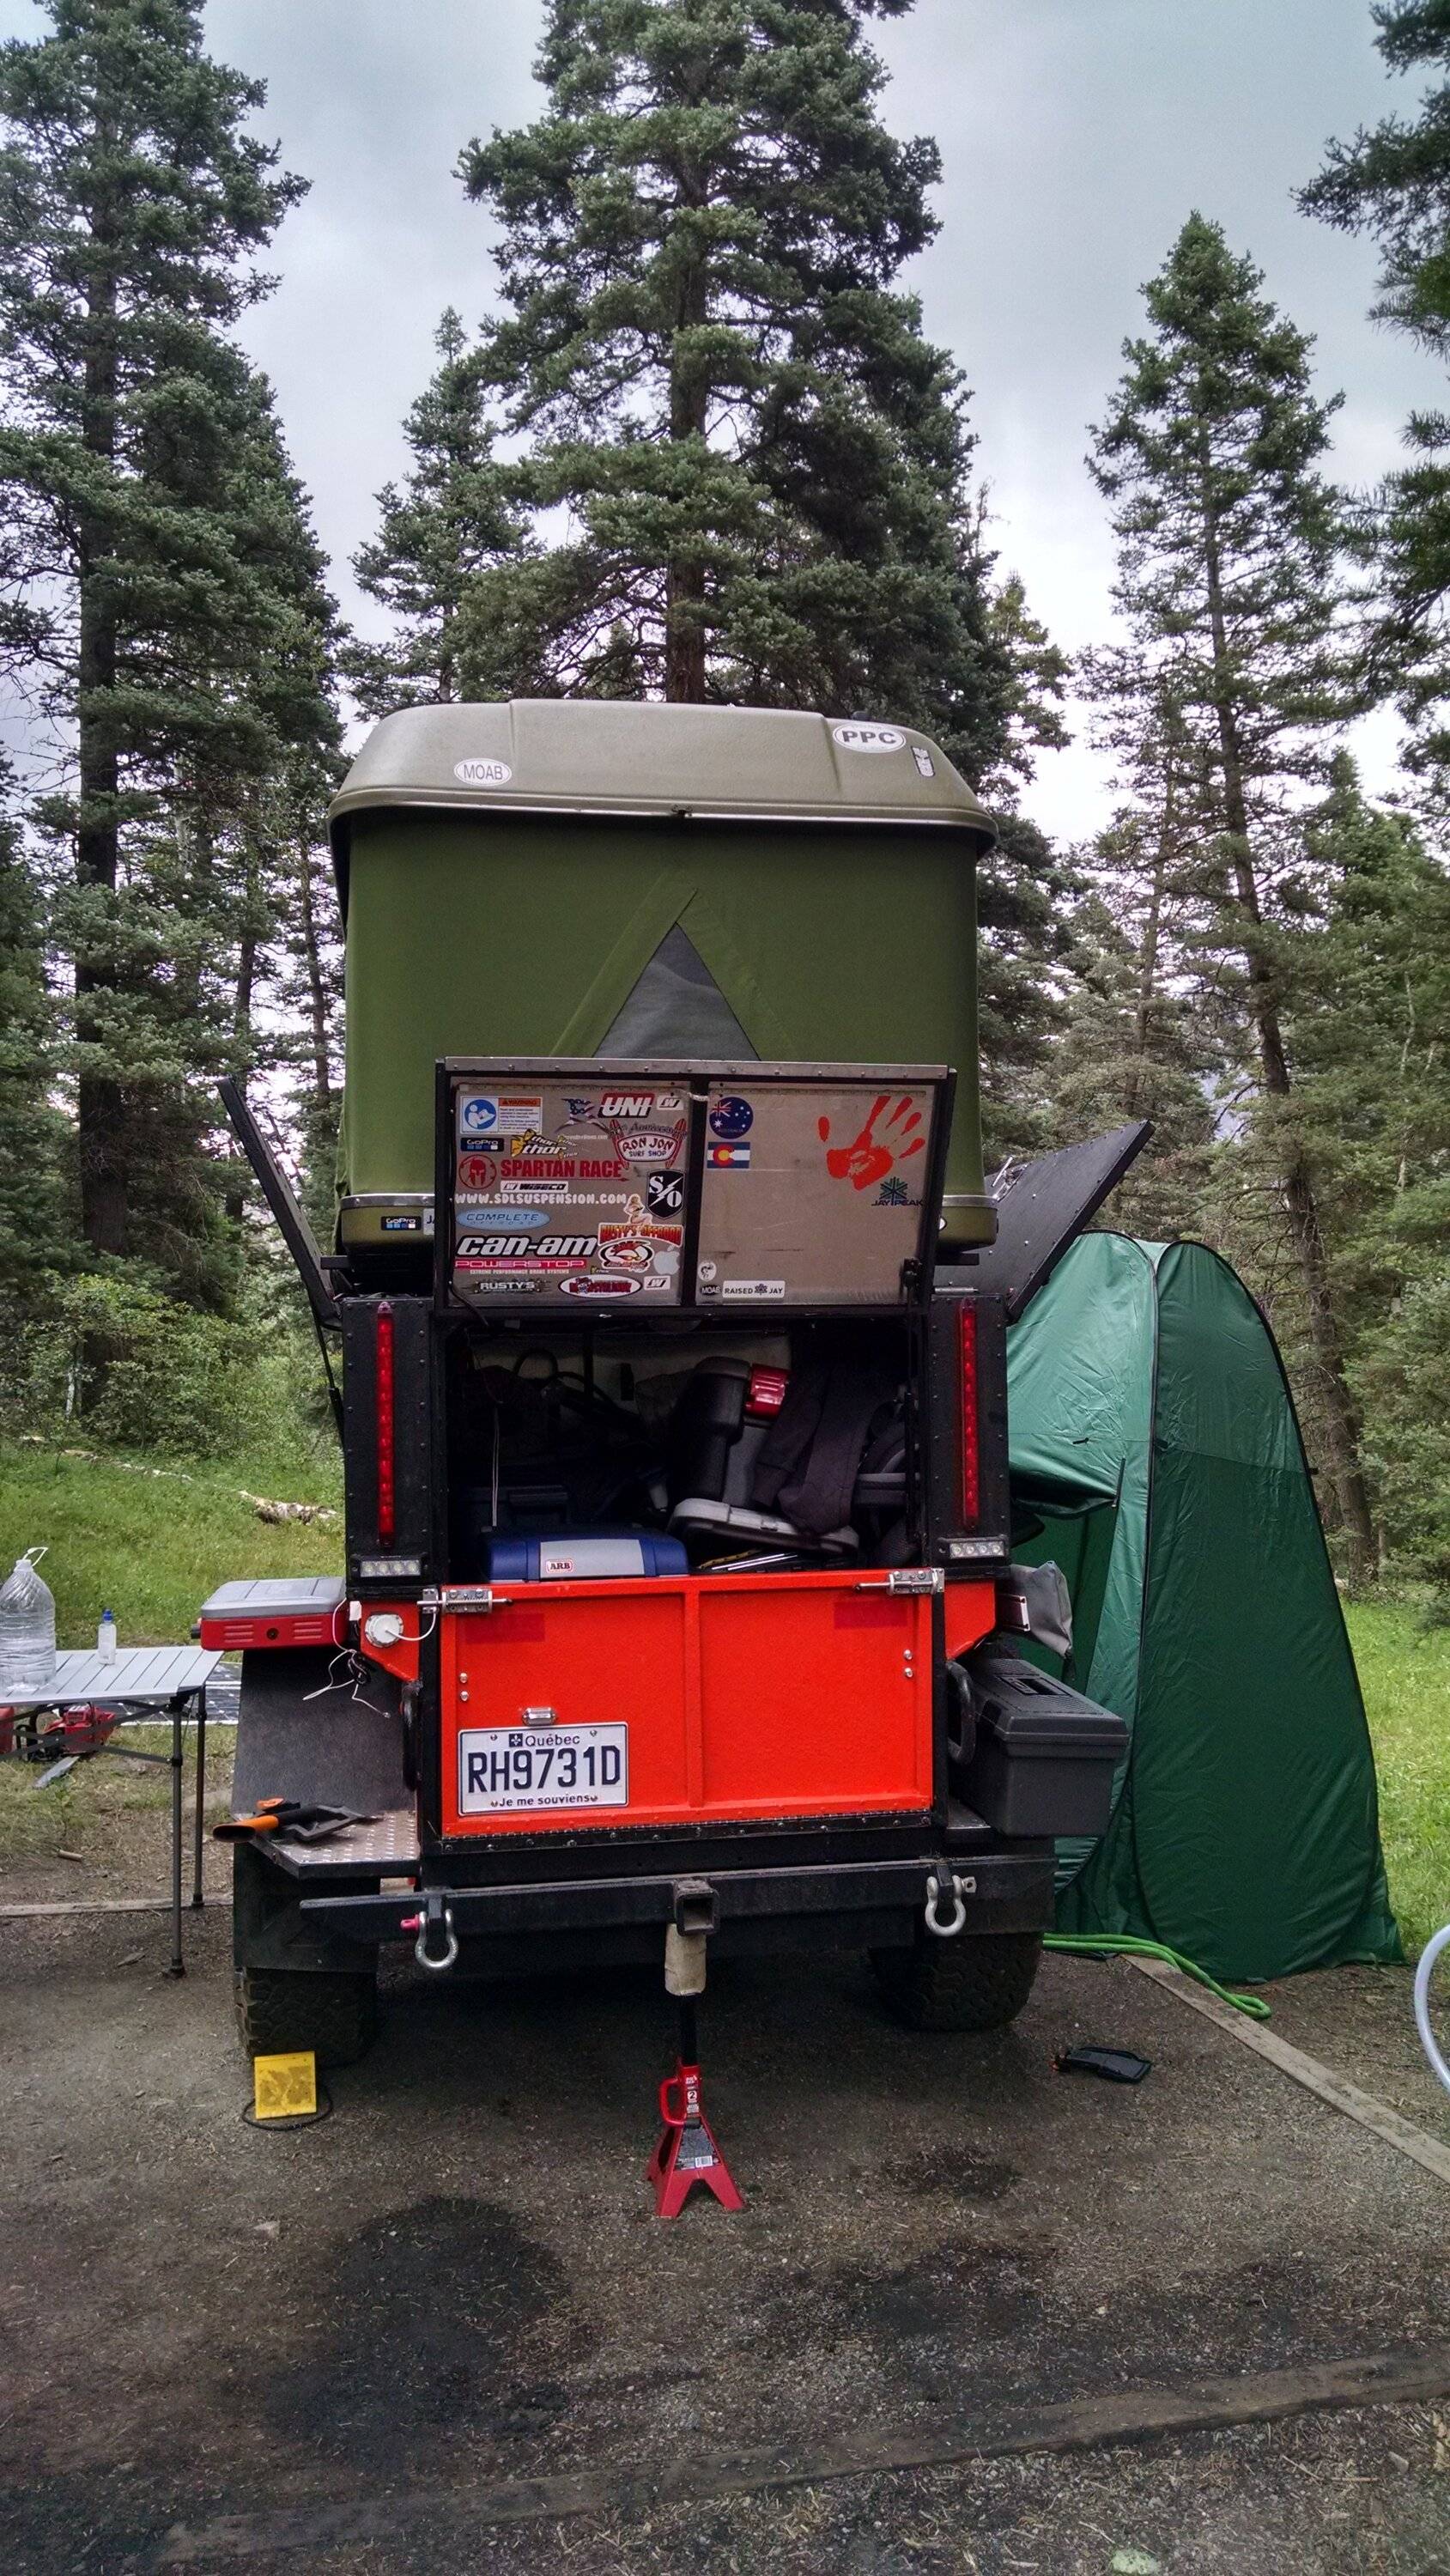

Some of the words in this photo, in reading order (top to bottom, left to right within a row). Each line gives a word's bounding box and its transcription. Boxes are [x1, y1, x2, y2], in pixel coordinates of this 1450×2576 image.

[841, 730, 896, 744] PPC
[464, 764, 503, 780] MOAB
[602, 1097, 652, 1116] UNI
[531, 1135, 557, 1146] thor
[622, 1137, 647, 1151] RON
[649, 1137, 674, 1151] JON
[521, 1144, 567, 1154] thor
[501, 1159, 575, 1177] SPARTAN
[579, 1160, 622, 1177] RACE
[455, 1193, 627, 1204] WWW.SDLSUSPENSION.COM
[457, 1236, 598, 1255] can-am
[480, 1281, 535, 1290] RUSTY'S
[525, 1734, 580, 1746] Québec
[468, 1745, 621, 1793] RH9731D
[499, 1797, 513, 1807] Je
[517, 1797, 534, 1806] me
[537, 1795, 590, 1805] souviens
